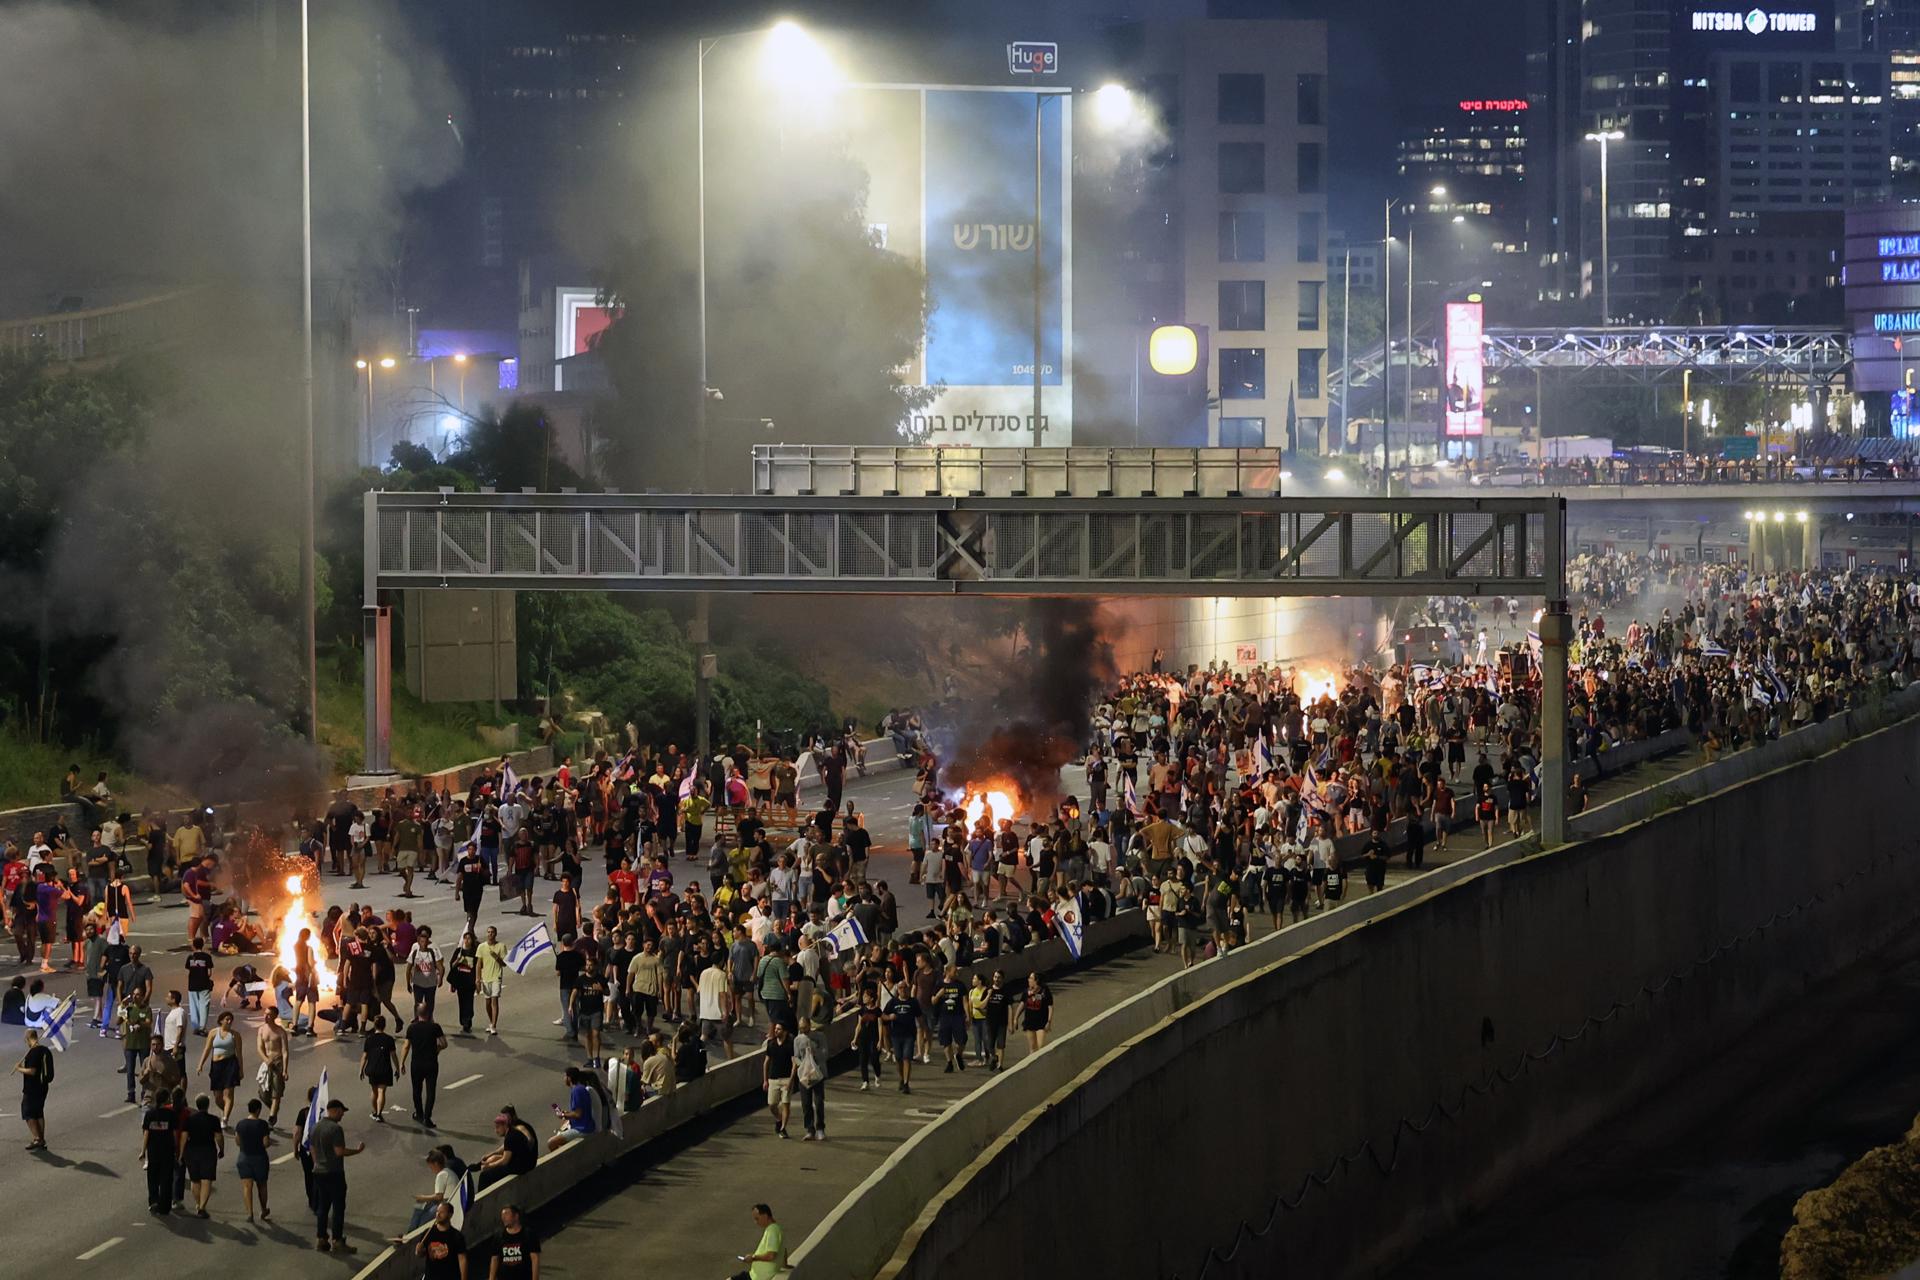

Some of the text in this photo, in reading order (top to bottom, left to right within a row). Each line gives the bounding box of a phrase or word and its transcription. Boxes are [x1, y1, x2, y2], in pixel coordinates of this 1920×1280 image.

[1692, 12, 1816, 31] NITSBA TOWER
[1012, 47, 1053, 73] Huge
[953, 223, 1034, 251] שורש
[952, 410, 1021, 432] סנדלים
[502, 1246, 522, 1256] FCK
